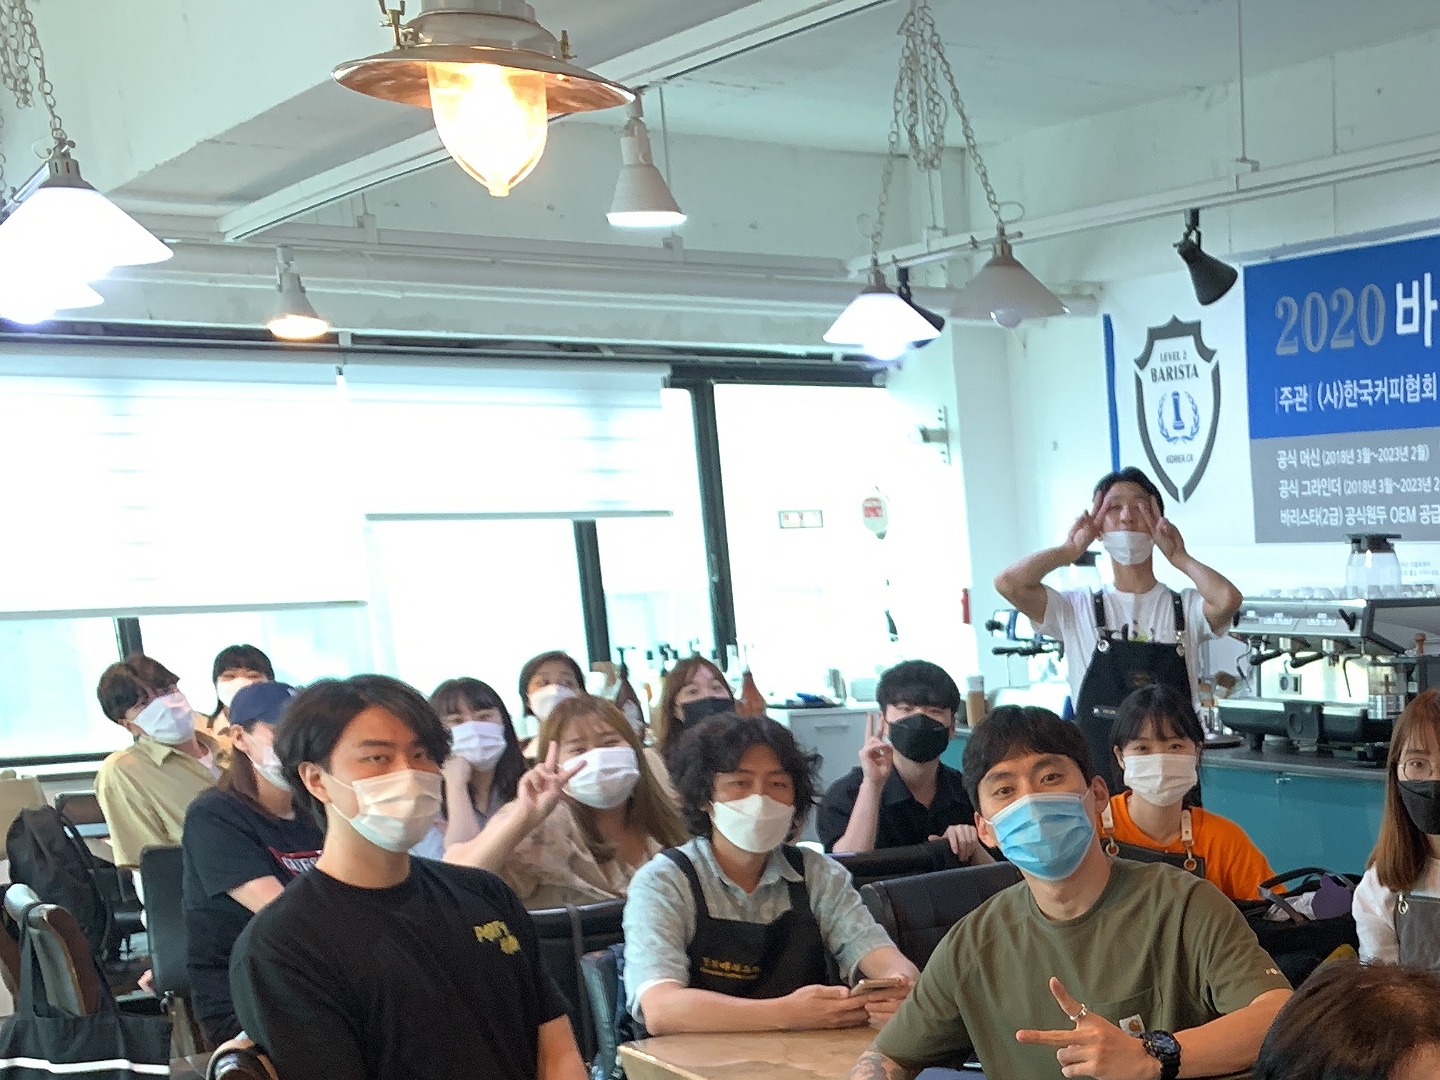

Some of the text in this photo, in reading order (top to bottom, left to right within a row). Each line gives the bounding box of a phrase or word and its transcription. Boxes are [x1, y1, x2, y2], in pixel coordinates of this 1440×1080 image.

[1275, 283, 1386, 356] 2020
[1151, 363, 1199, 383] BARISTA
[1279, 384, 1309, 413] 주관
[1317, 372, 1437, 411] (사)한국커피협회
[1277, 449, 1297, 470] 공식
[1279, 479, 1298, 499] 공식
[1390, 506, 1417, 524] OEM
